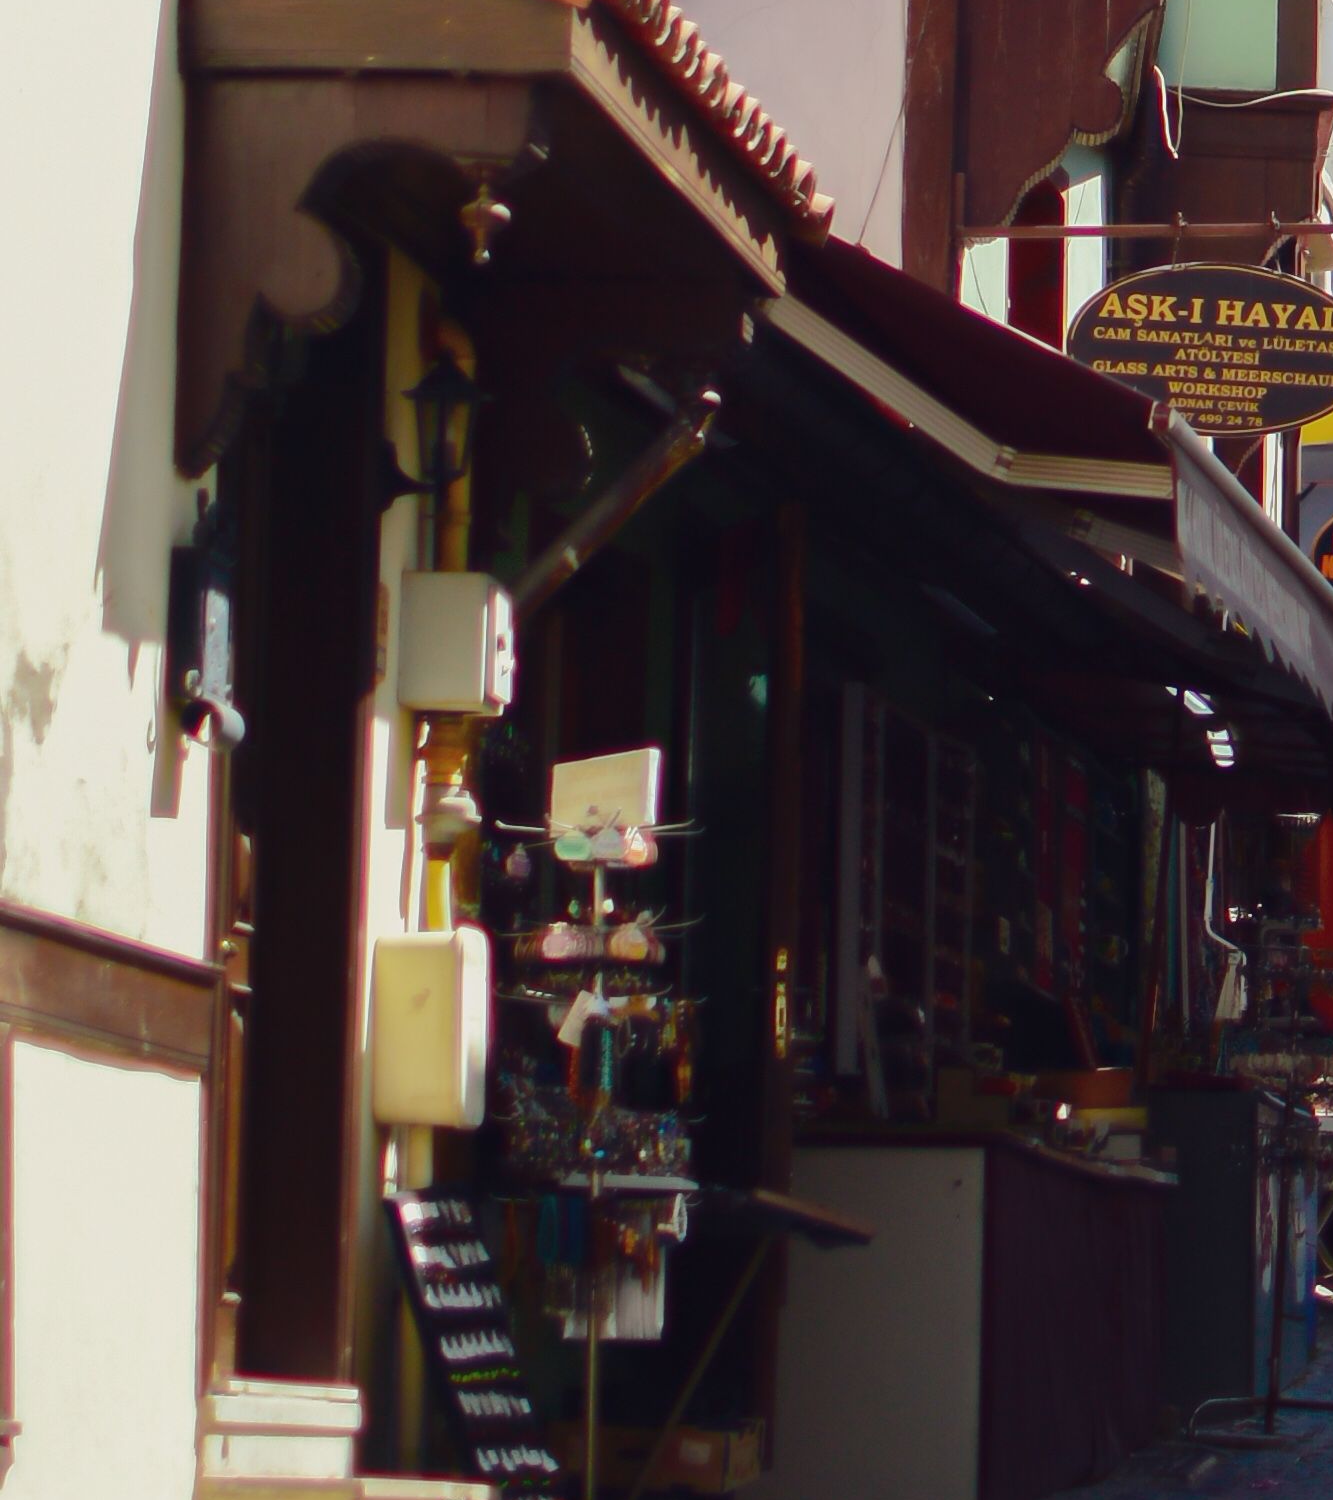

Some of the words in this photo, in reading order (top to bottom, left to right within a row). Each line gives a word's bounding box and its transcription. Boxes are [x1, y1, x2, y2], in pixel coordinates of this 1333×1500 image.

[1099, 293, 1204, 327] AŞK-I
[1093, 327, 1131, 341] CAM
[1137, 329, 1232, 347] SANATLARI
[1239, 338, 1256, 348] ve
[1175, 347, 1260, 365] ATÖLYESİ
[1093, 360, 1148, 375] GLASS
[1152, 364, 1198, 379] ARTS
[1203, 367, 1216, 380] &
[1168, 381, 1267, 399] WORKSHOP
[1168, 397, 1213, 409] ADNAN
[1218, 401, 1259, 413] ÇEVİK
[1198, 413, 1223, 425] 499
[1226, 415, 1243, 425] 24
[1247, 416, 1263, 427] 78
